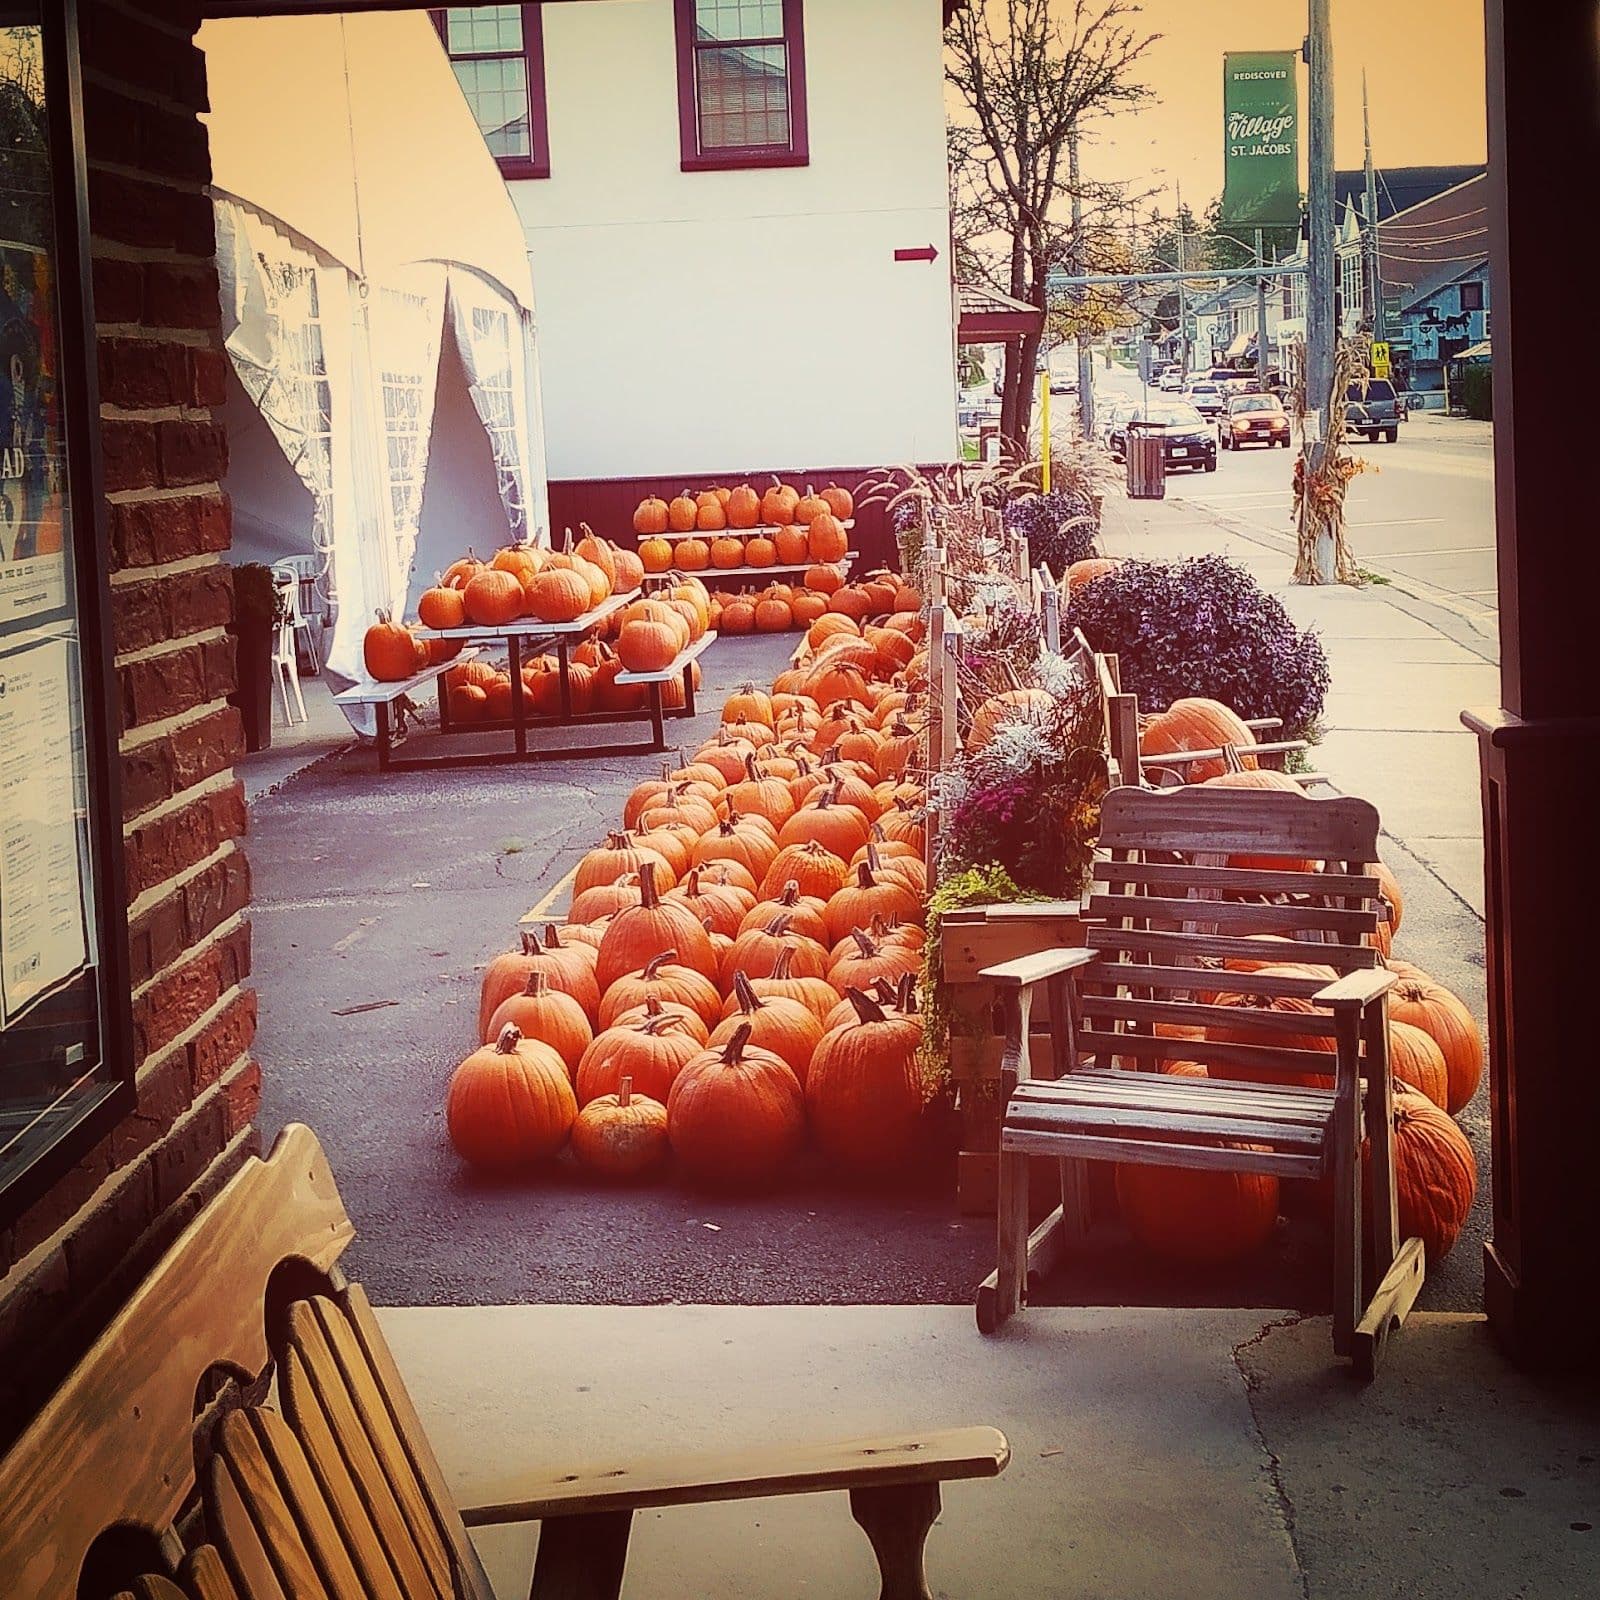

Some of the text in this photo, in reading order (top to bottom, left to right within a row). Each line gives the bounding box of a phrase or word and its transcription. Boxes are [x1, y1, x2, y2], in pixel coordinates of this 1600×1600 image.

[1233, 71, 1287, 80] REDISCOVER
[1229, 112, 1248, 124] The
[1228, 115, 1294, 140] Village
[1262, 133, 1271, 143] of
[1231, 143, 1291, 156] ST. JACOBS
